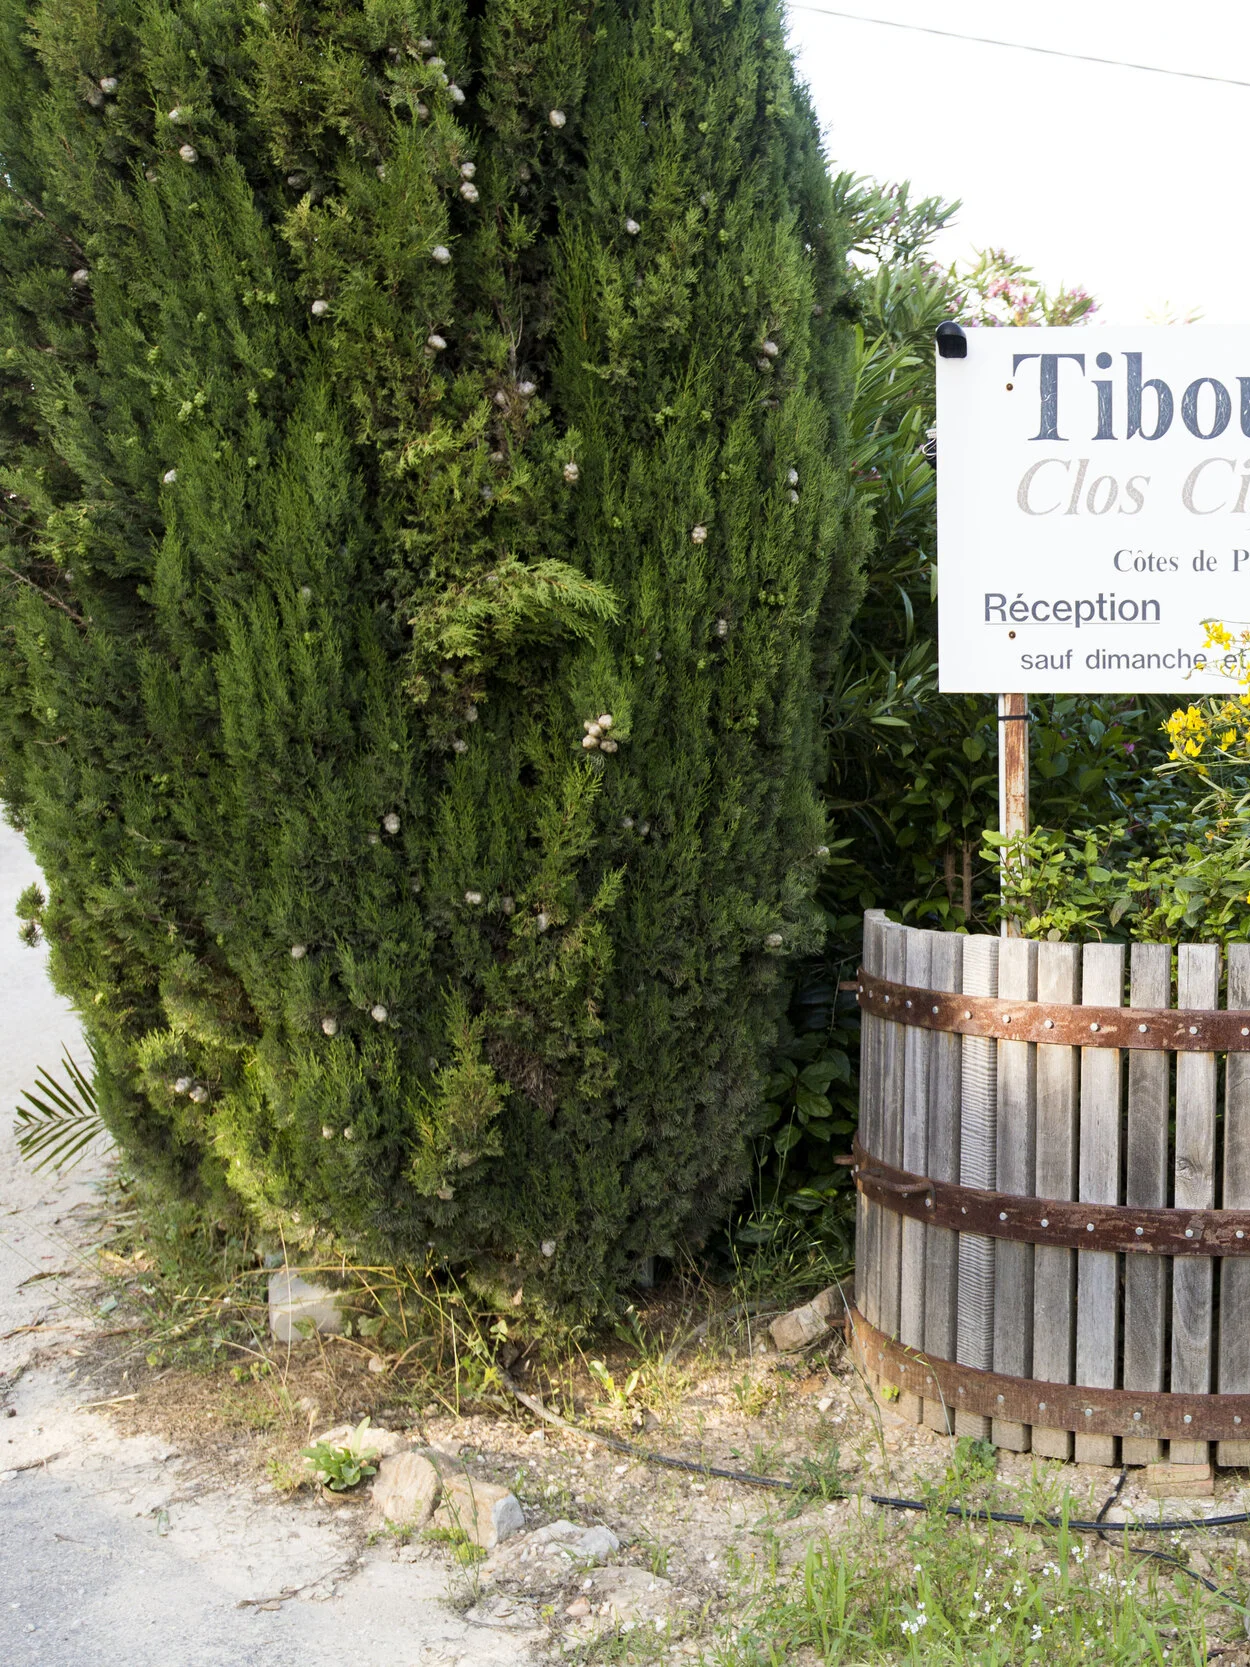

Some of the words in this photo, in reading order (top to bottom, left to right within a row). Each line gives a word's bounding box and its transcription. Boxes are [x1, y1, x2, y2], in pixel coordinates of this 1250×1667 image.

[1016, 457, 1151, 516] Clos
[1113, 548, 1179, 573] Côtes
[1192, 549, 1218, 573] de
[984, 592, 1161, 628] Réception
[1020, 649, 1073, 671] sauf
[1085, 648, 1208, 671] dimanche
[1223, 650, 1248, 671] et
